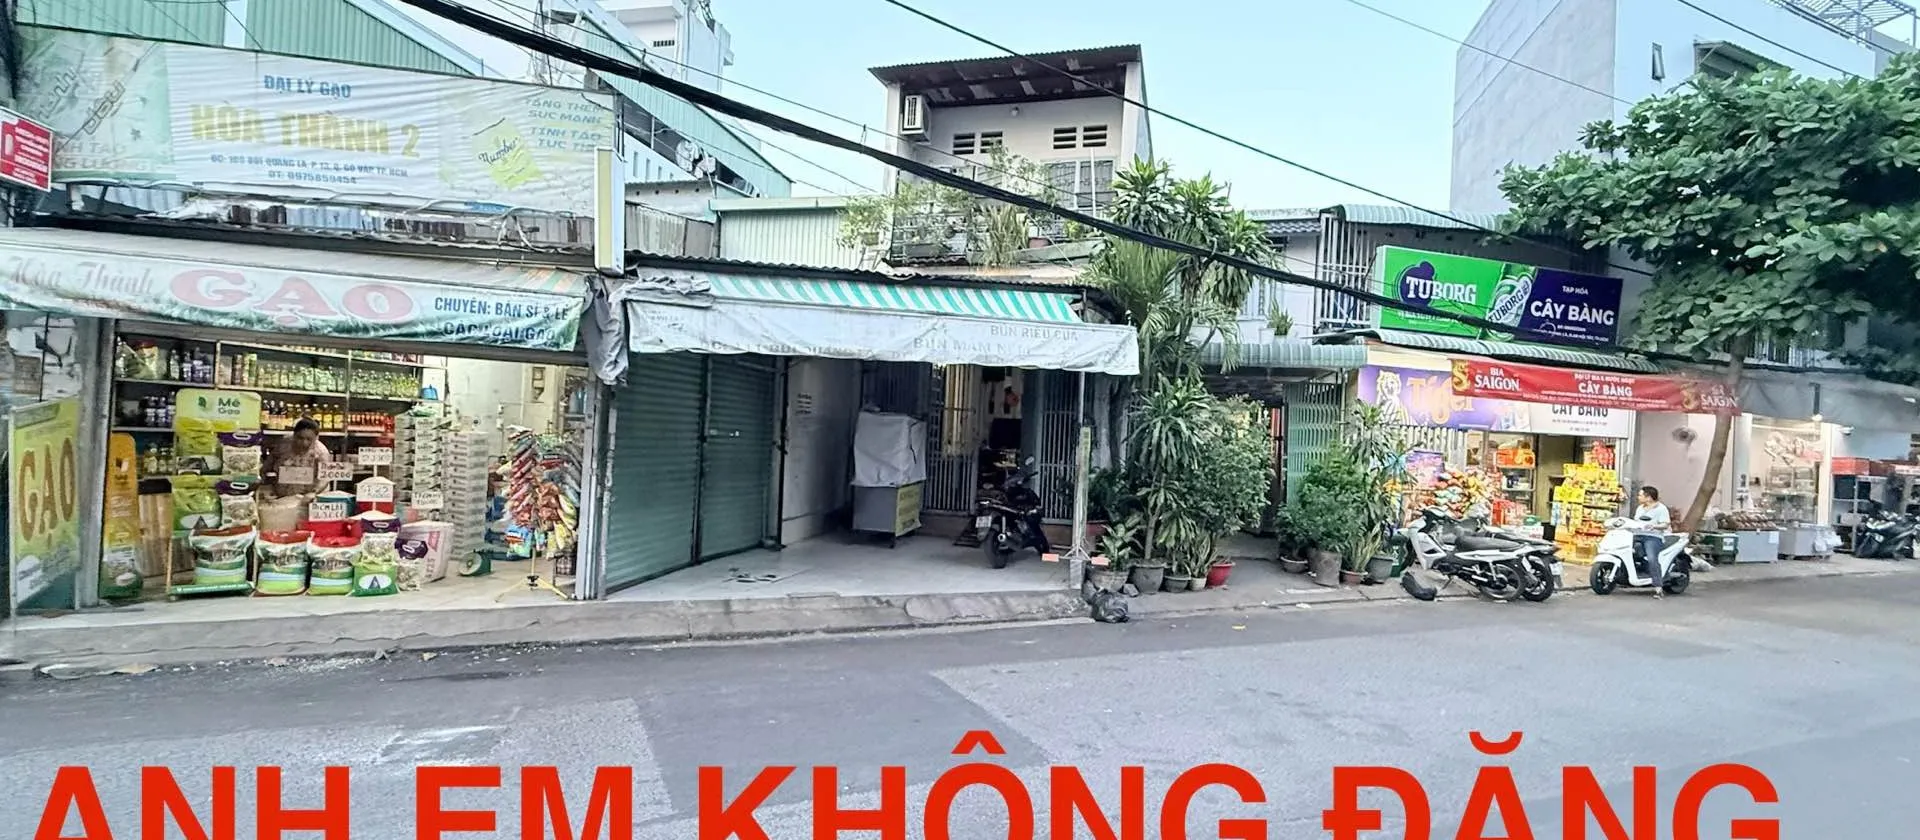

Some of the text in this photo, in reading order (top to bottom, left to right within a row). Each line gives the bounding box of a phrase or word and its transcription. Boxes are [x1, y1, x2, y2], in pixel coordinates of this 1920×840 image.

[320, 80, 352, 100] GẠO
[402, 123, 421, 158] 2
[169, 269, 414, 325] GẠO
[1406, 275, 1477, 306] TUBORG
[434, 297, 491, 316] CHUYÊN:
[495, 301, 521, 318] BÁN
[1530, 298, 1615, 326] CÂY BÀNG
[1474, 374, 1520, 392] SAIGON
[1489, 368, 1504, 377] BIA
[1578, 381, 1600, 394] CÂY
[1602, 383, 1633, 397] BÀNG
[19, 436, 76, 543] GẠO
